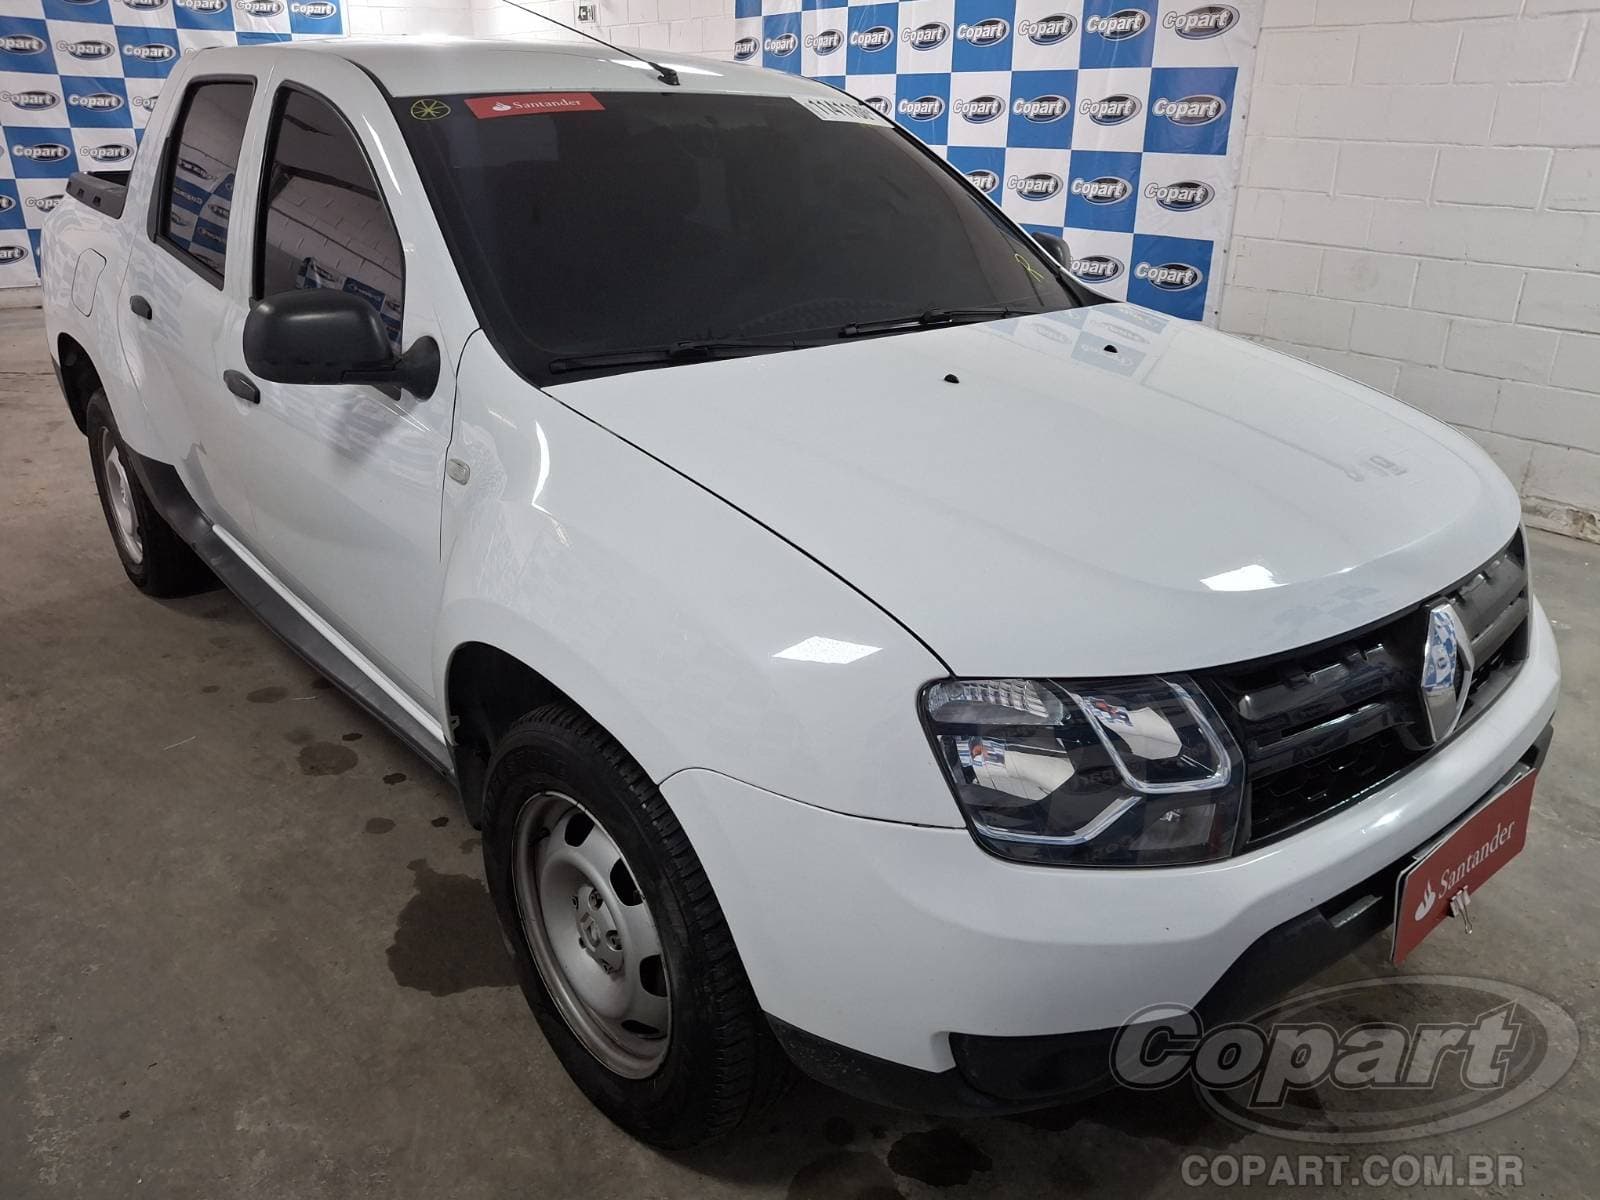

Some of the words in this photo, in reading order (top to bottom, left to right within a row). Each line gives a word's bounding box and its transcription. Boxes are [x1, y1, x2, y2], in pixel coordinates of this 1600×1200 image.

[290, 3, 332, 15] Copart
[1018, 17, 1072, 39] Copart
[1086, 12, 1144, 36] Copart
[1163, 9, 1233, 32] Copart
[849, 29, 889, 47] Copart
[901, 27, 944, 44] Copart
[957, 22, 1003, 42] Copart
[56, 40, 107, 55] Copart
[123, 44, 170, 57] Copart
[764, 37, 794, 54] Copart
[804, 34, 839, 52] Copart
[0, 91, 51, 105] Copart
[69, 93, 118, 108] Copart
[513, 98, 581, 110] Santander
[898, 98, 940, 116] Copart
[953, 98, 999, 116] Copart
[1013, 98, 1065, 116] Copart
[1079, 98, 1135, 119] Copart
[1152, 97, 1221, 120] Copart
[13, 144, 65, 159] Copart
[80, 145, 128, 159] Copart
[1007, 174, 1057, 193] Copart
[1071, 178, 1127, 198] Copart
[1144, 183, 1205, 203] Copart
[1070, 258, 1115, 277] opart
[1135, 262, 1194, 284] Copart
[1438, 821, 1515, 900] Santander
